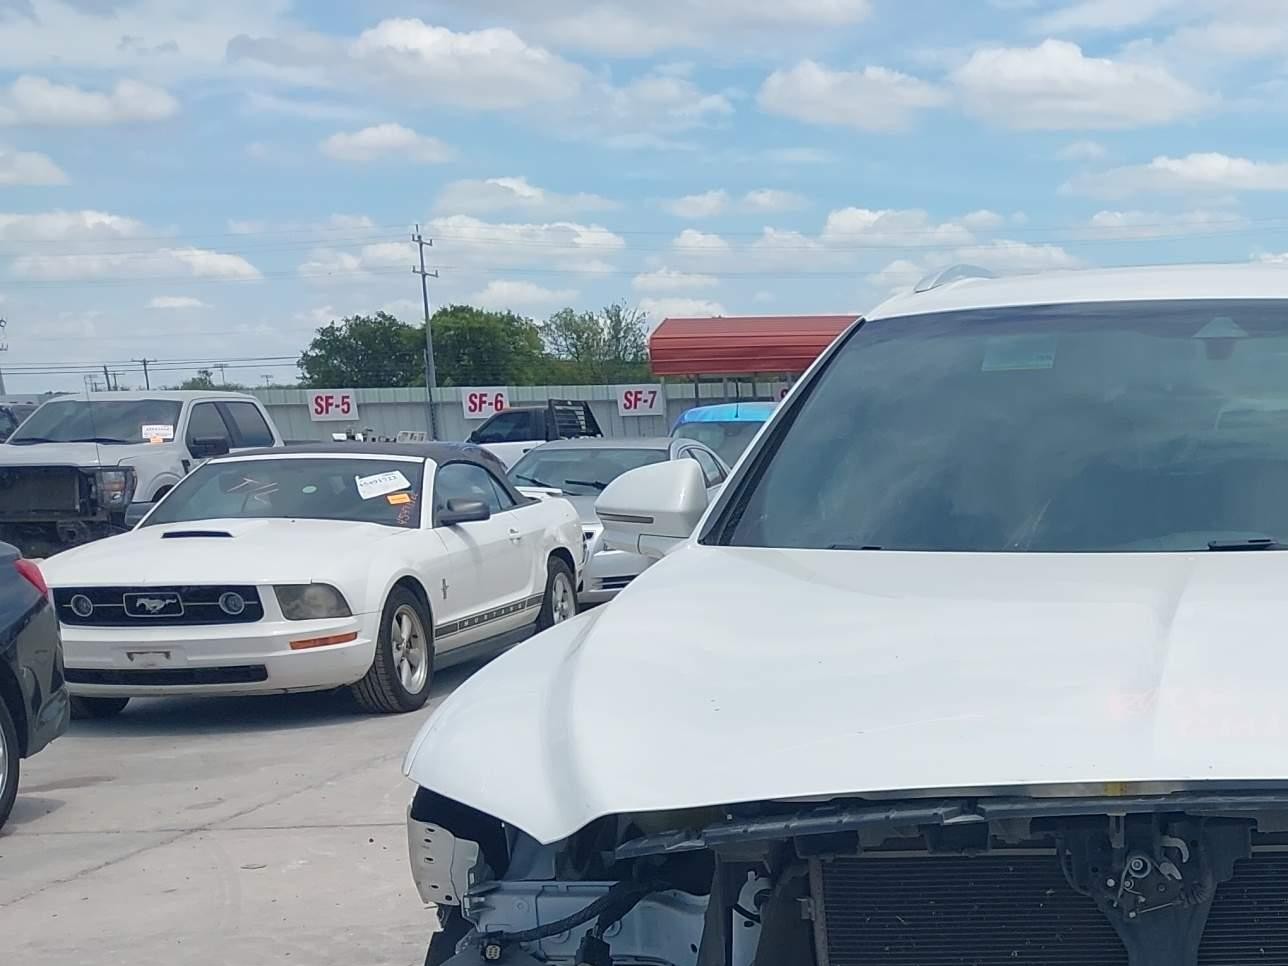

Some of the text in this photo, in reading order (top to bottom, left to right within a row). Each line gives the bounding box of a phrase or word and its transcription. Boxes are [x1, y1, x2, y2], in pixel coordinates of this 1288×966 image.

[314, 395, 351, 415] SF-5
[468, 393, 504, 413] SF-6
[623, 391, 658, 410] SF-7
